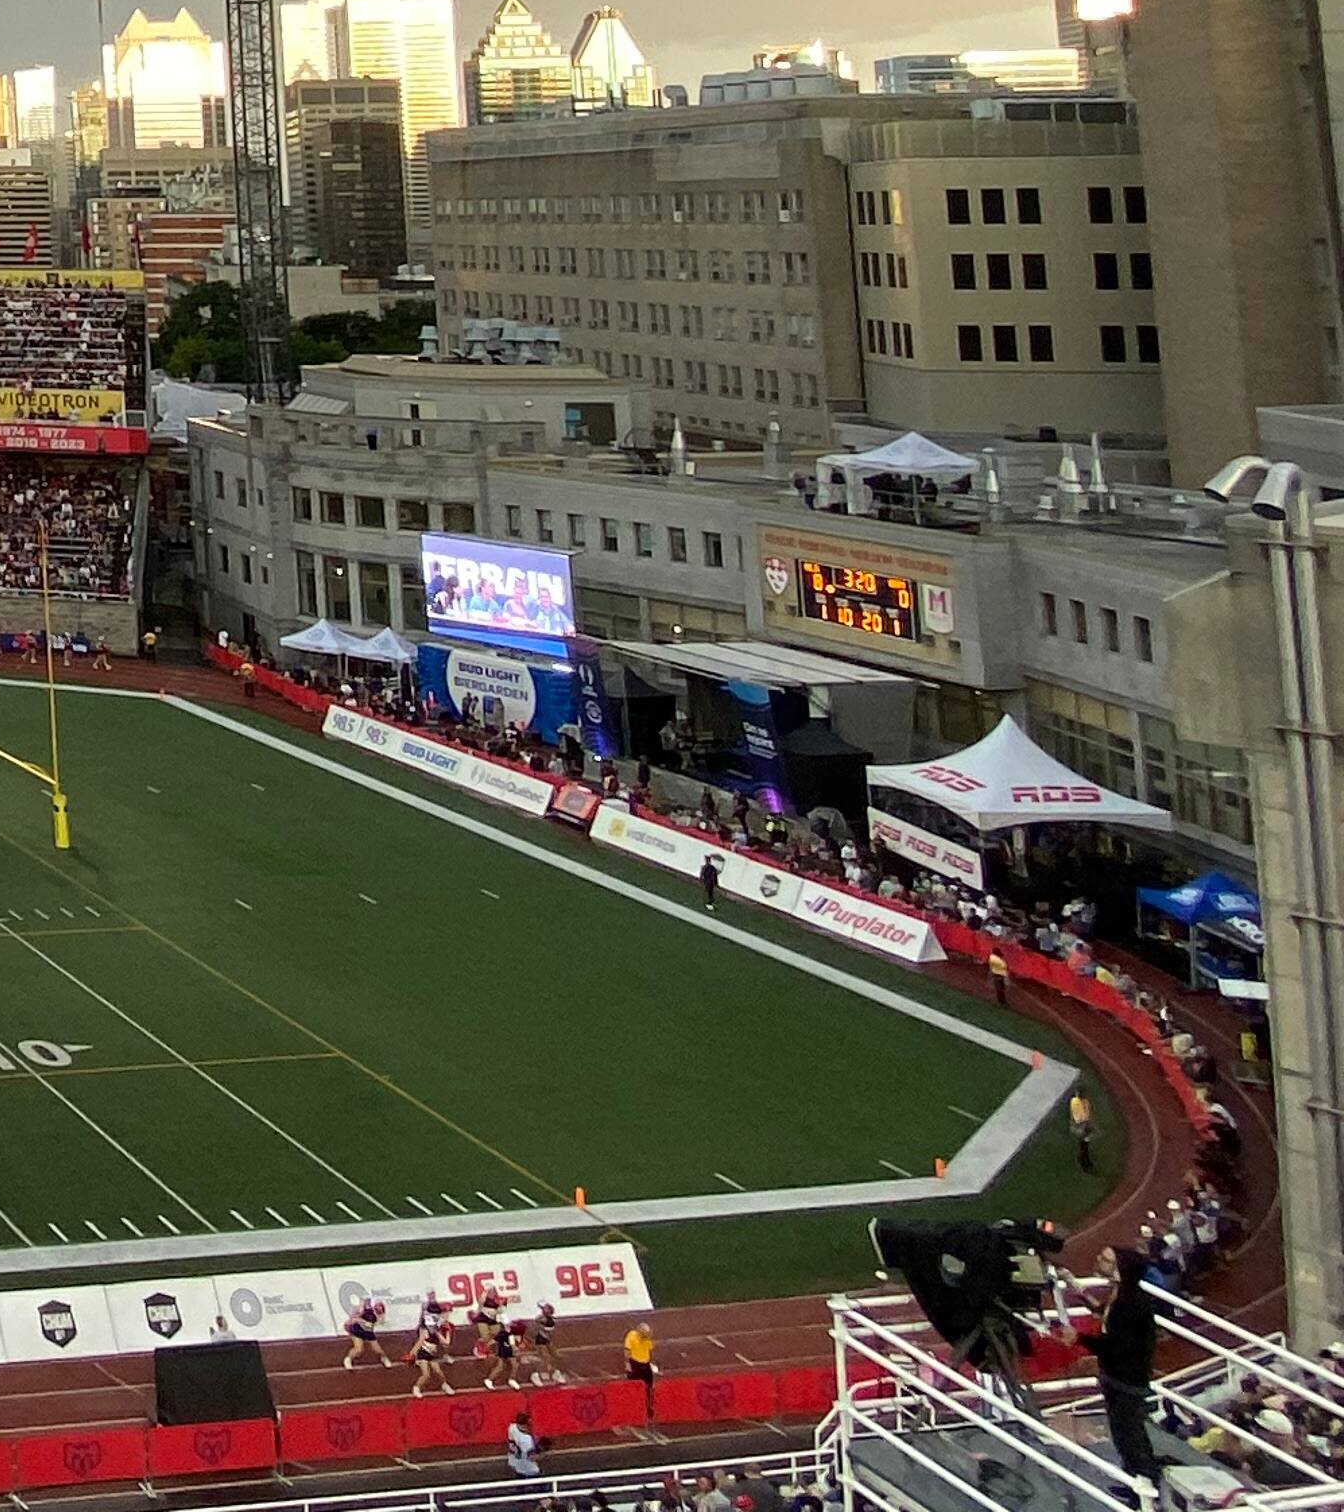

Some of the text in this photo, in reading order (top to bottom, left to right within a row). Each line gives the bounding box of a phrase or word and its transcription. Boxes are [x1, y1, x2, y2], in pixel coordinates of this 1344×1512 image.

[458, 661, 521, 683] BUD LIGHT
[402, 741, 458, 772] BUD LIGHT
[822, 900, 915, 945] Purolator
[555, 1261, 625, 1299] 96.9
